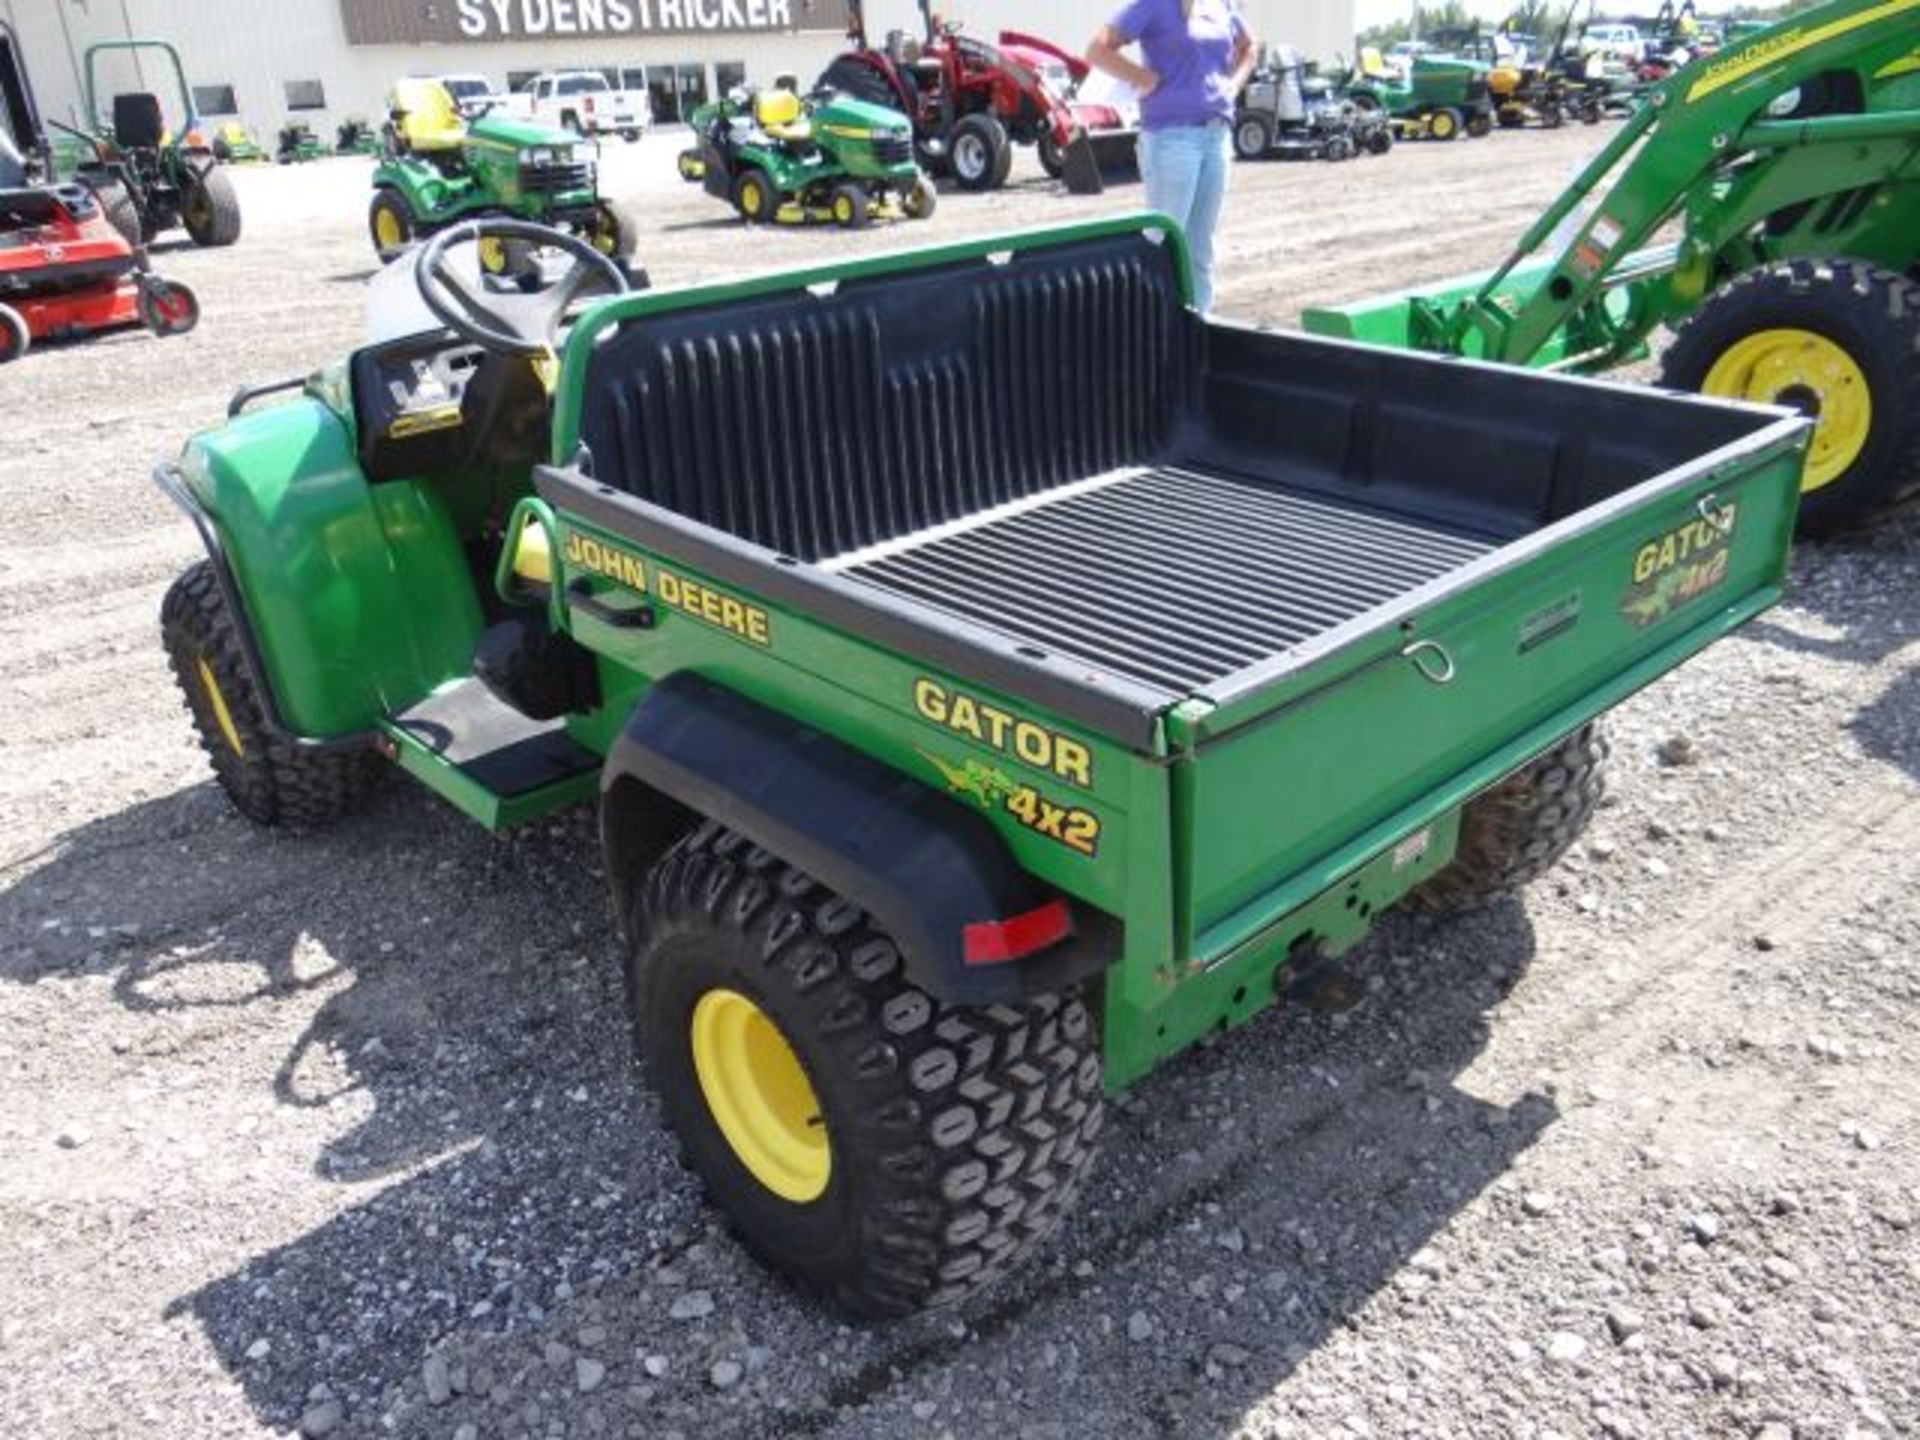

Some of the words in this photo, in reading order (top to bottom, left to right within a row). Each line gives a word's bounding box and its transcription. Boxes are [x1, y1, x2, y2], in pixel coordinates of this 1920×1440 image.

[458, 0, 792, 36] SYDENSTRICKER
[566, 531, 648, 592] JOHN
[657, 570, 771, 647] DEERE
[914, 677, 1092, 787] GATOR
[1006, 785, 1101, 857] 4x2
